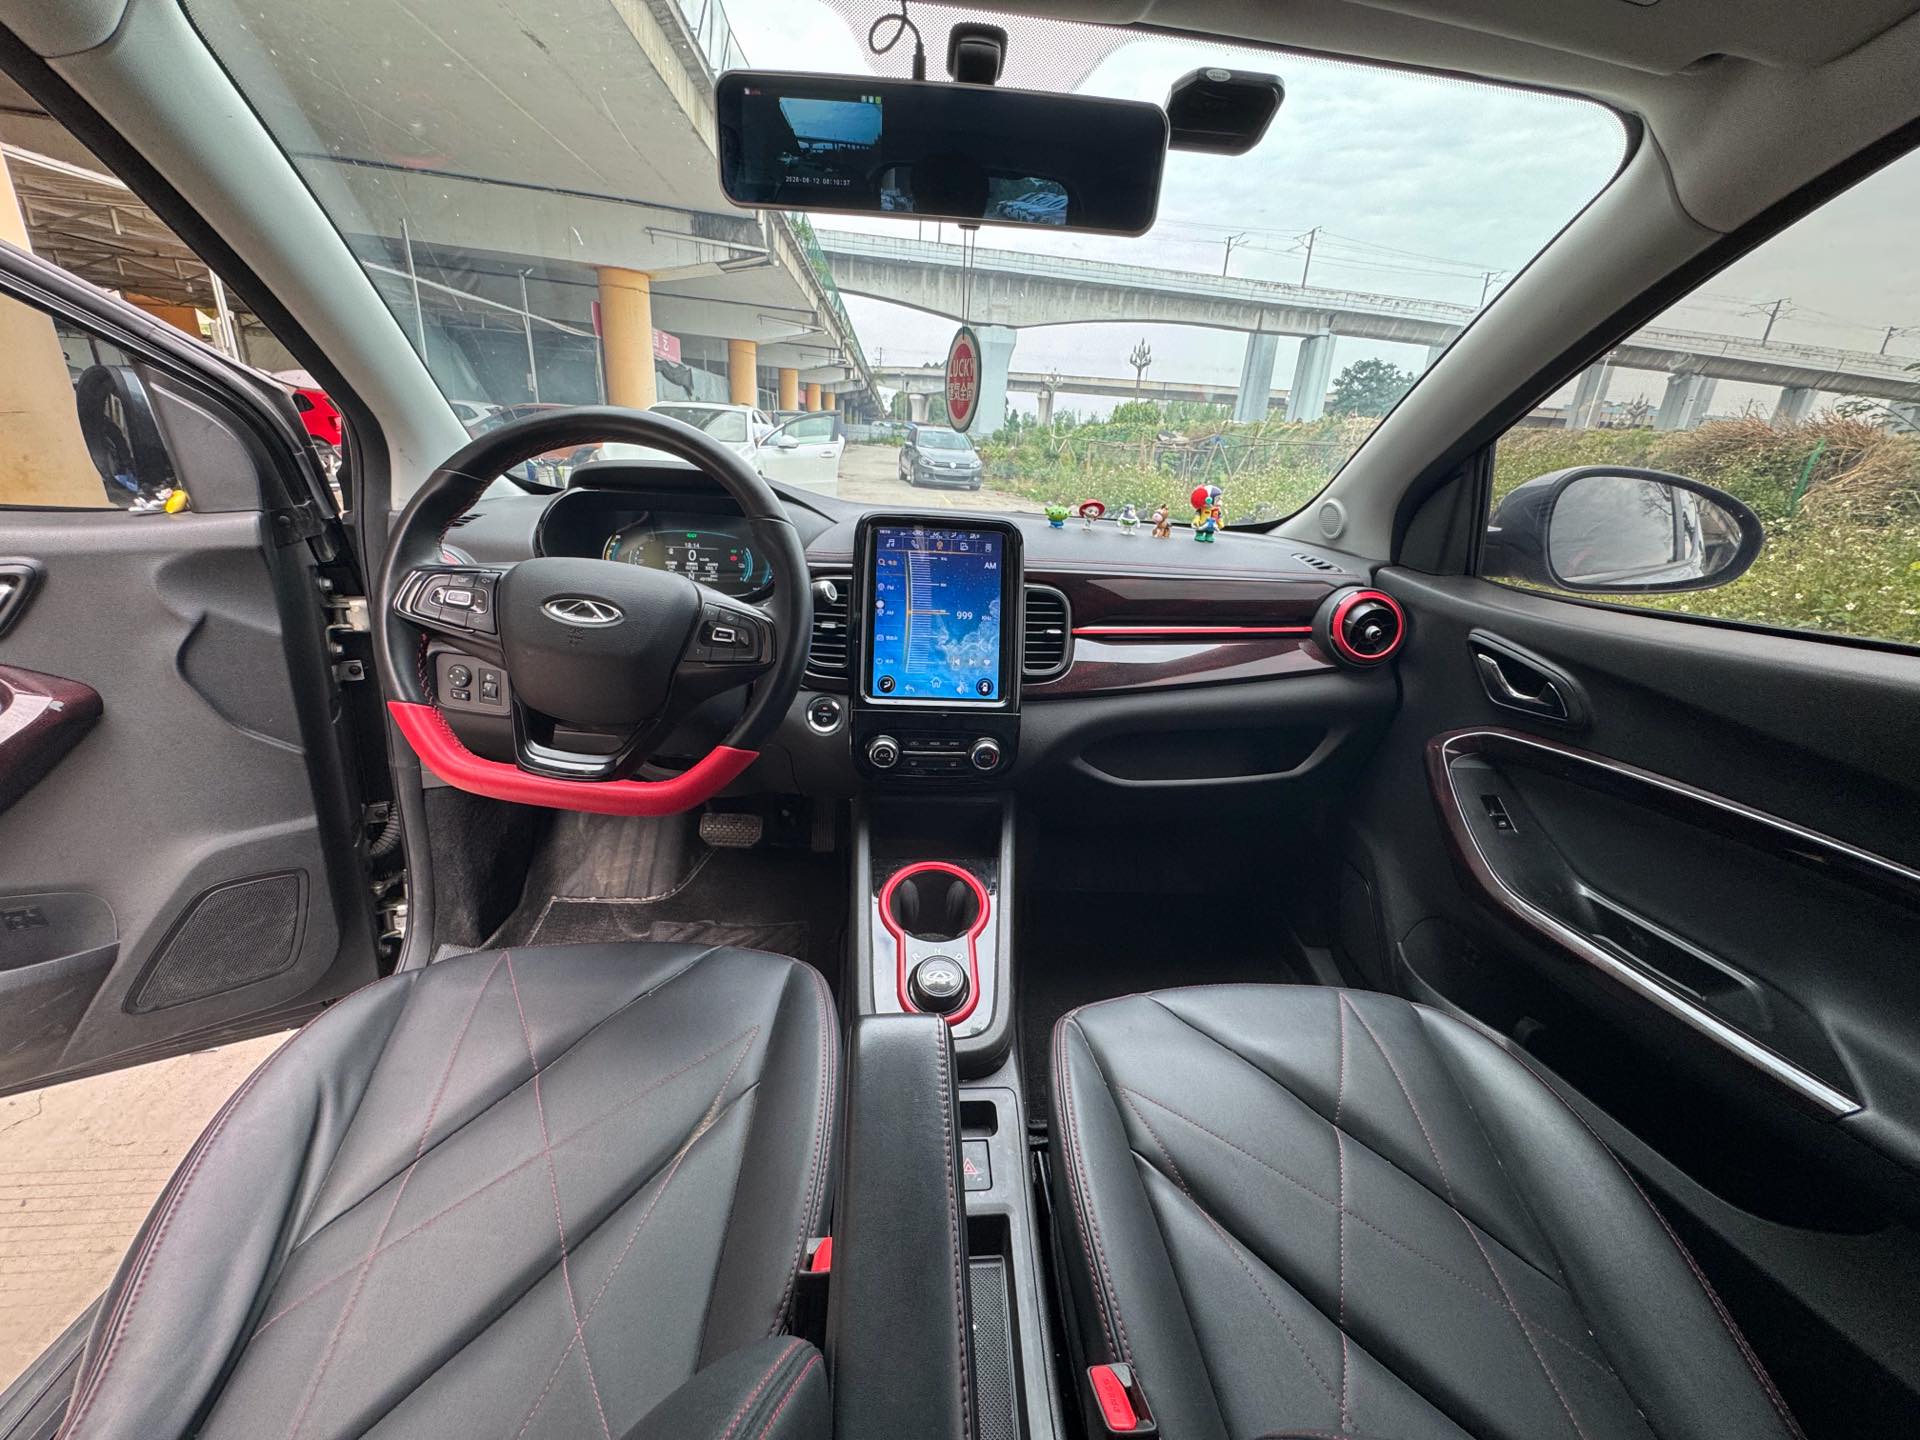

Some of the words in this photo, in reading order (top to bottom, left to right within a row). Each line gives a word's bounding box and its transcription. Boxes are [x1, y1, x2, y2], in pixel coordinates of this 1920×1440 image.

[949, 357, 976, 377] LUCKY
[688, 549, 697, 561] 0
[984, 561, 997, 569] AM
[956, 611, 973, 620] 999
[934, 947, 941, 955] N
[912, 952, 921, 960] R
[955, 952, 963, 960] D
